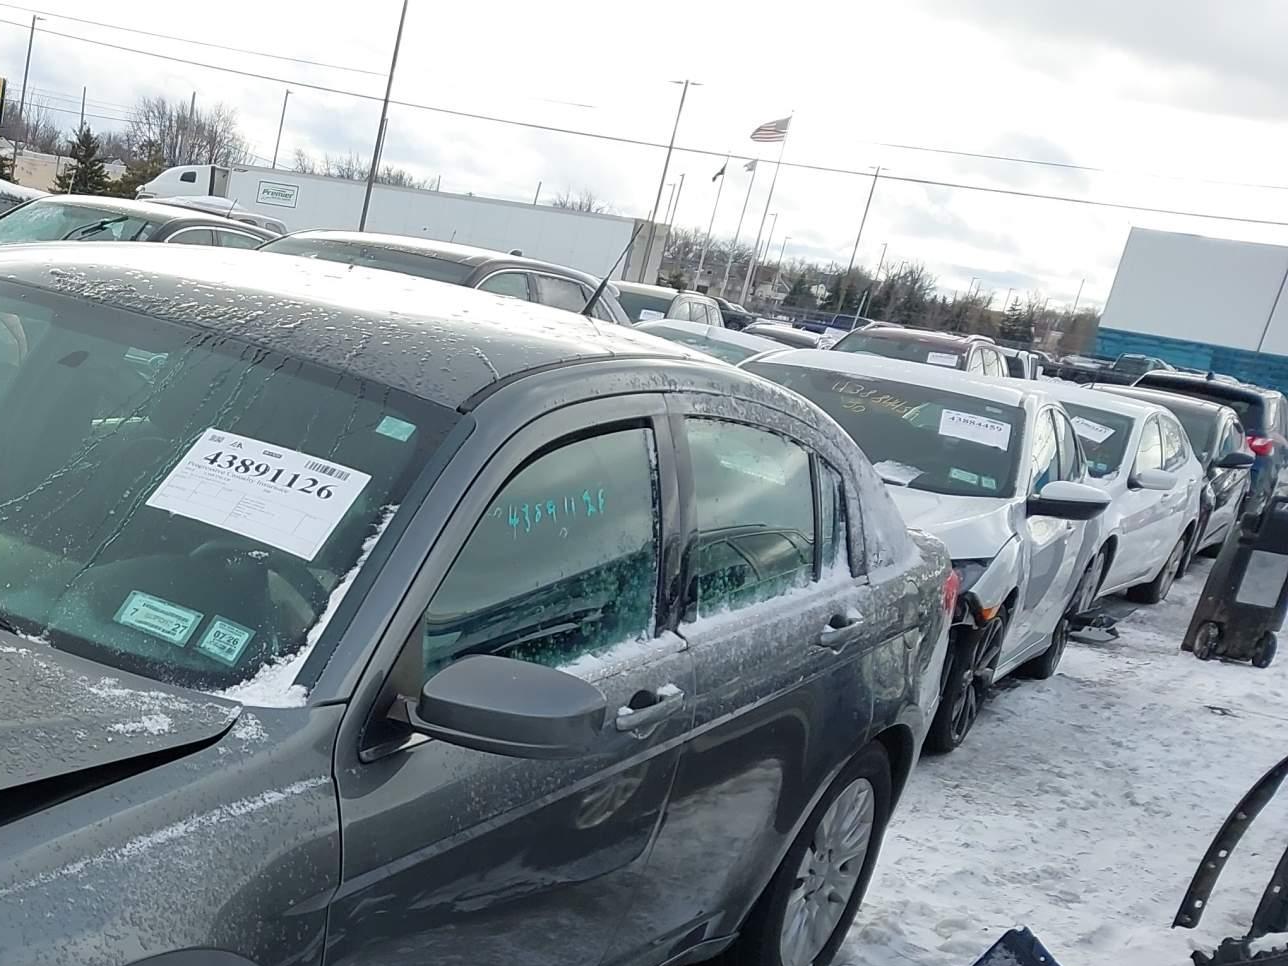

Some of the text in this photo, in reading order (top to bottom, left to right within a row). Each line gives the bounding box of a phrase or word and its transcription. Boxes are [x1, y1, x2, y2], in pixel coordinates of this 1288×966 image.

[262, 187, 295, 199] Premier
[203, 450, 339, 500] 43891126
[130, 607, 139, 617] 7
[171, 622, 189, 635] 27
